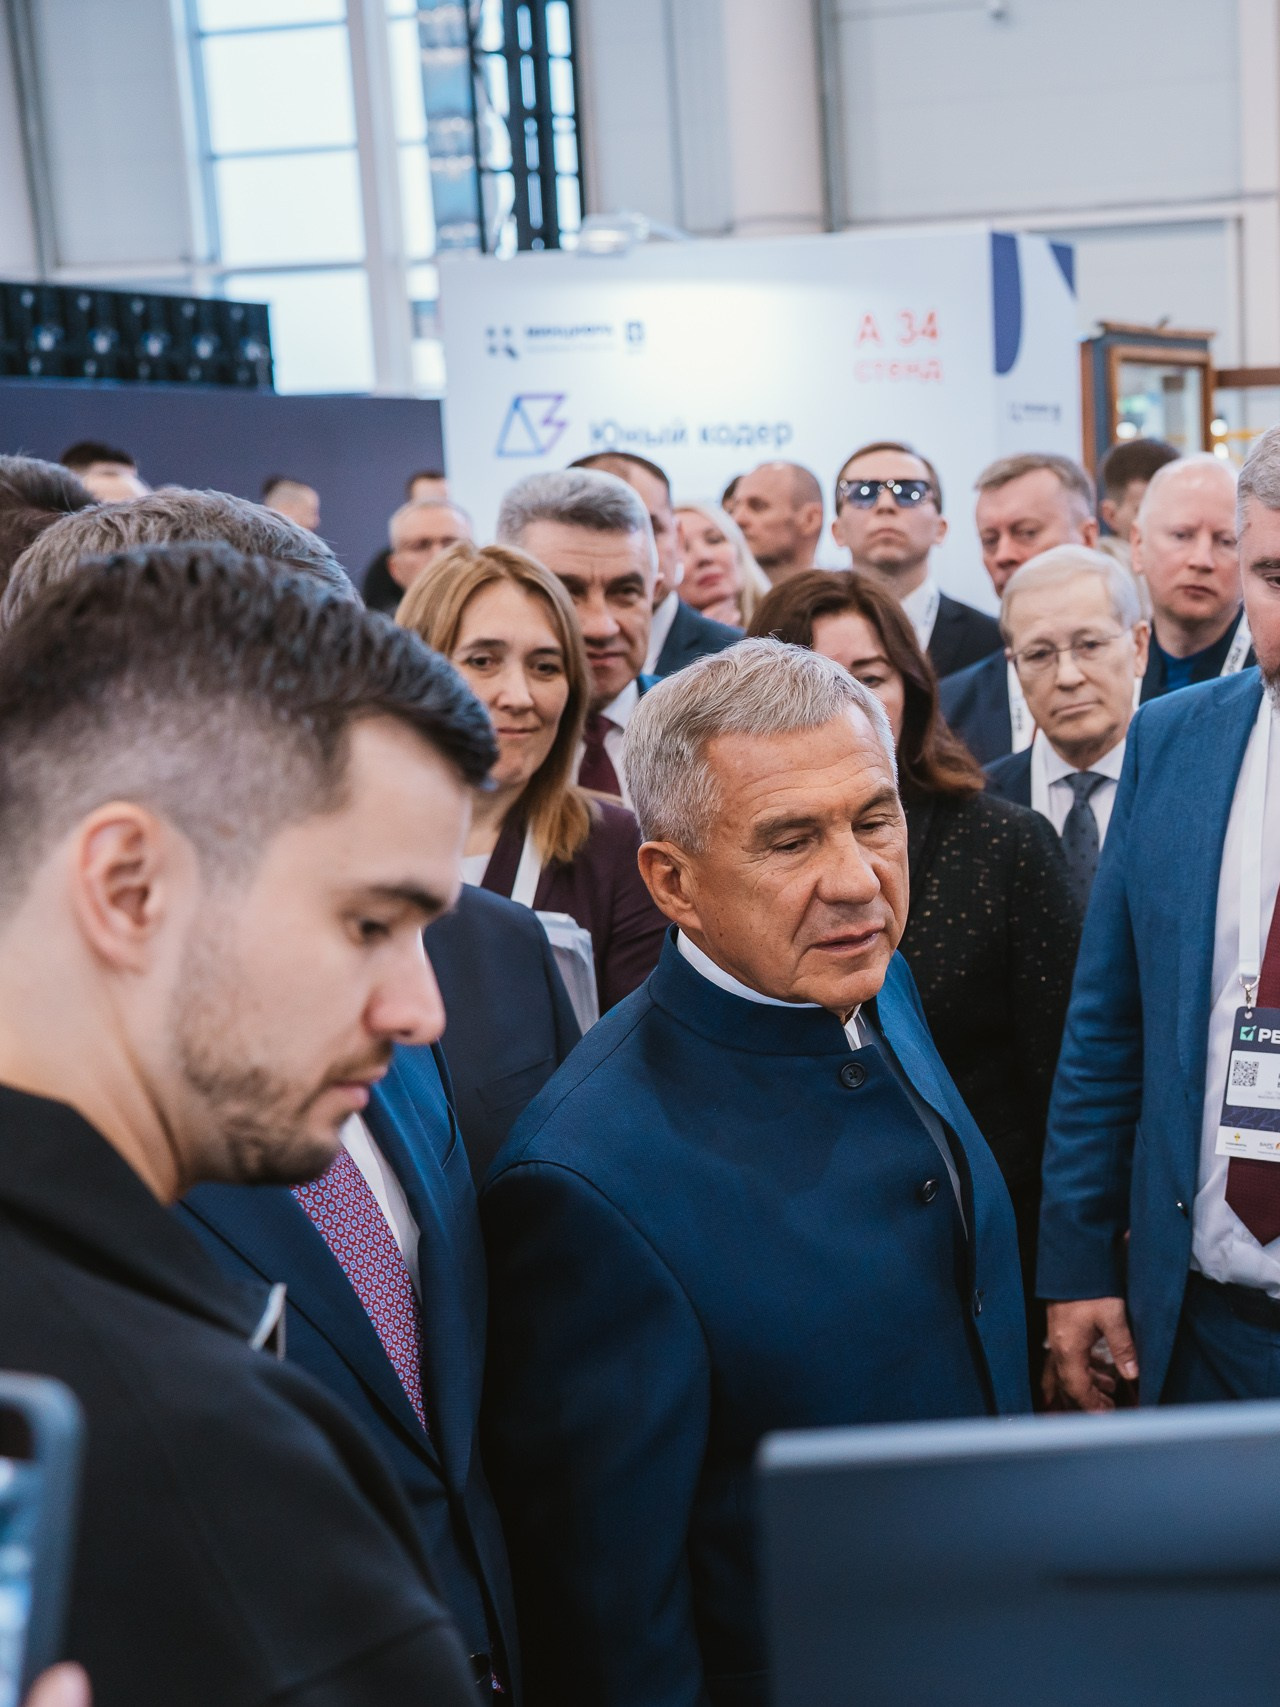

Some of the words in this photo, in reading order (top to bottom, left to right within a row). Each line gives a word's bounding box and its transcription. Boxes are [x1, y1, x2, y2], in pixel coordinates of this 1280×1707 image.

[898, 308, 939, 347] 34
[590, 417, 688, 447] Юный
[699, 420, 793, 448] кодер
